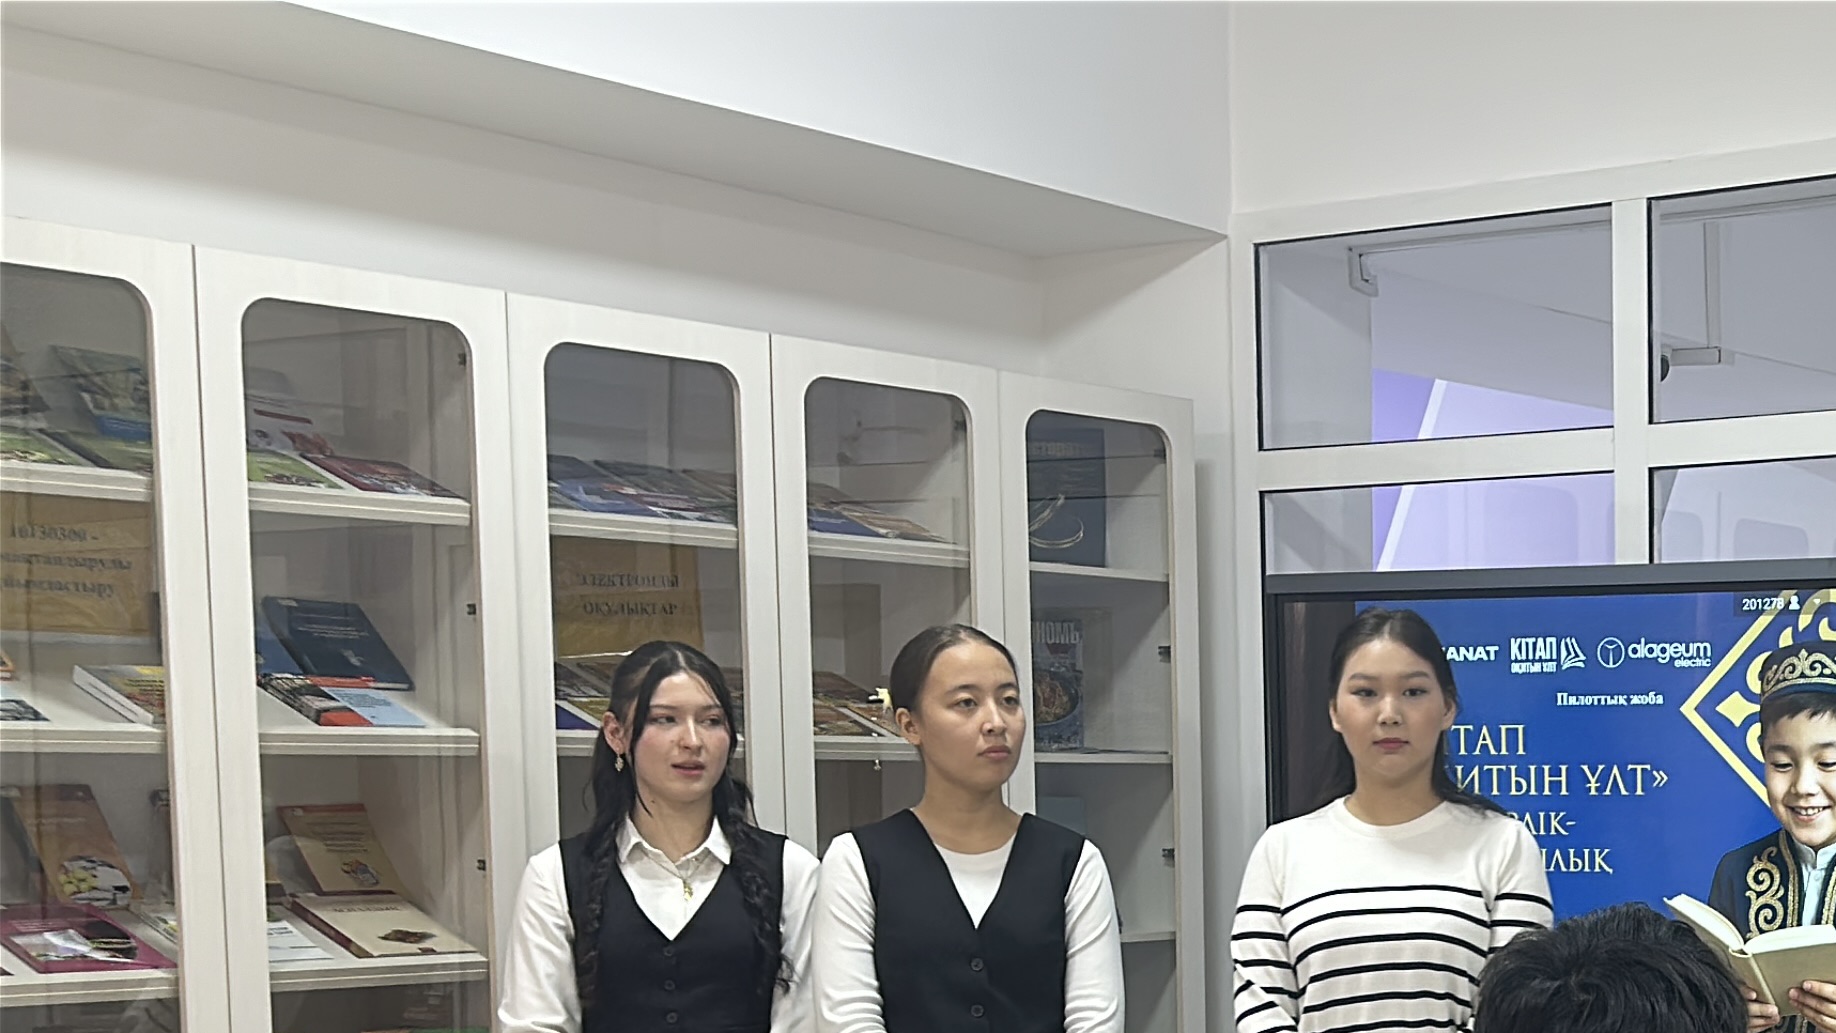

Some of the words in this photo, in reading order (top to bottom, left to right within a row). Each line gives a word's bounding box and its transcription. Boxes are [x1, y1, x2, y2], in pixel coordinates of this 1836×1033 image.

[1742, 598, 1785, 611] 201278
[1442, 645, 1499, 662] ANAT
[1627, 637, 1712, 664] alageum
[1674, 657, 1712, 667] electric
[1449, 724, 1526, 755] ТАП
[1454, 763, 1570, 796] ИТЫН
[1510, 811, 1577, 835] ЛІК-
